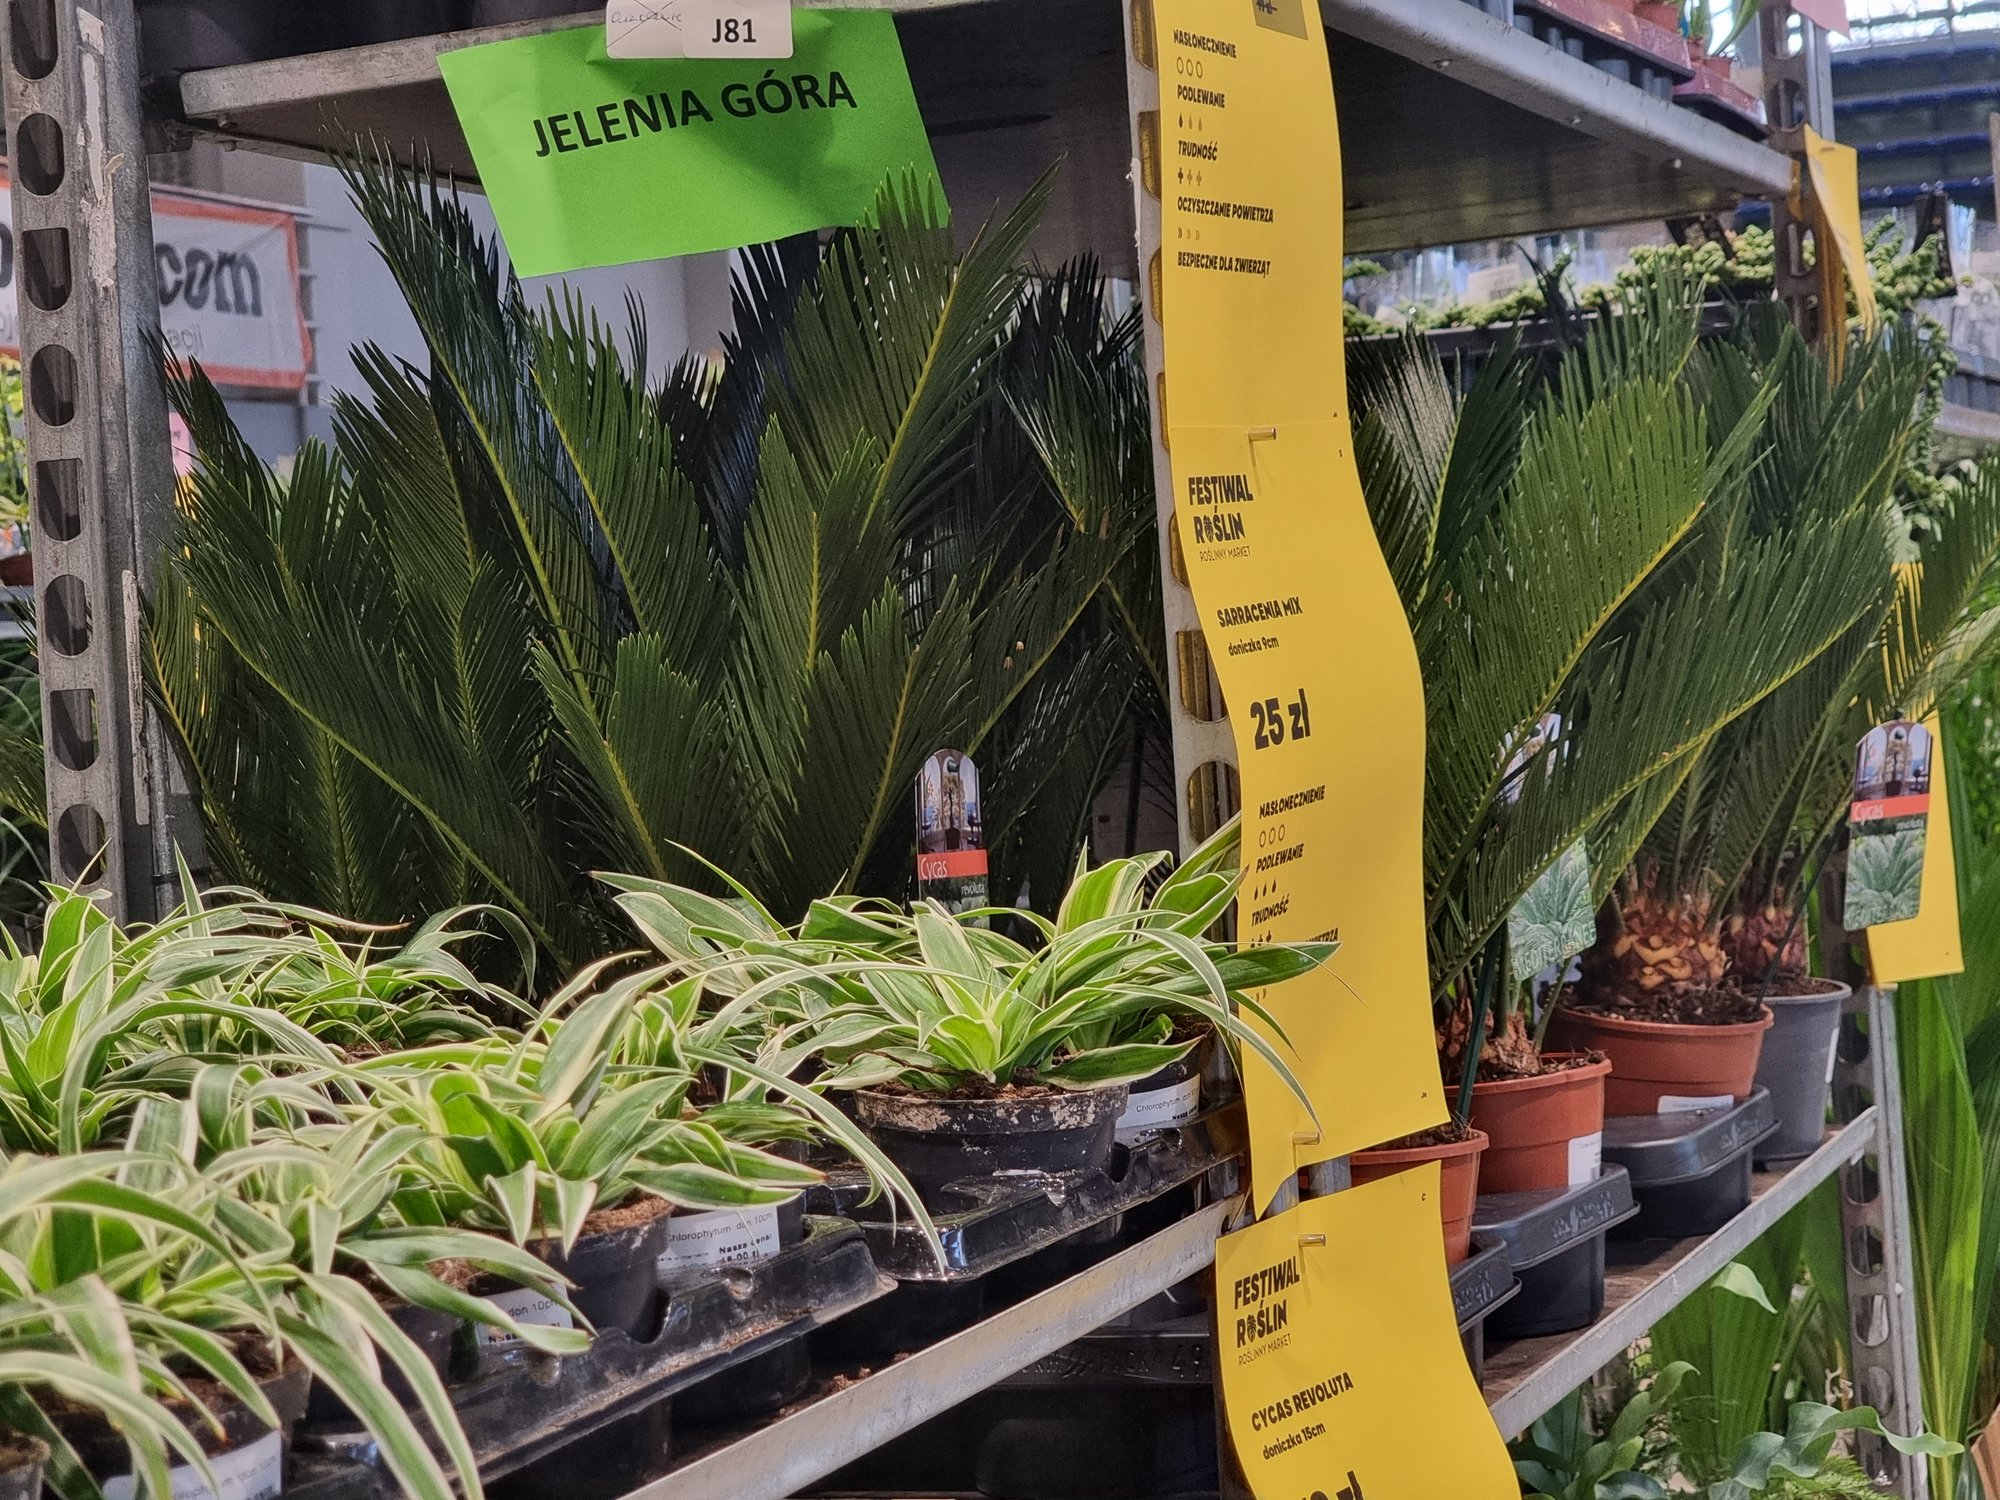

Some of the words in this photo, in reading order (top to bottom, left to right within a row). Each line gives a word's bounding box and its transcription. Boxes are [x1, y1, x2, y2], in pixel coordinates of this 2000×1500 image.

[712, 18, 757, 43] J81
[1174, 29, 1237, 58] NASŁONECZNIENIE
[1177, 84, 1226, 108] PODLEWANIE
[535, 89, 713, 158] JELENIA
[721, 70, 858, 118] GÓRA
[1178, 140, 1218, 161] TRUDNOŚĆ
[1177, 196, 1231, 218] OCZYSZCZANIE
[1231, 207, 1274, 223] POWIETRZA
[1177, 251, 1218, 271] BEZPIECZNE
[1219, 257, 1233, 272] DLA
[1234, 258, 1271, 279] ZWIERZĄT
[1188, 474, 1254, 505] FESTIWAL
[1193, 505, 1246, 544] ROŚLIN
[1227, 545, 1251, 559] MARKET
[1217, 599, 1283, 628] SARRACENIA
[1281, 596, 1303, 617] MIX
[1228, 638, 1262, 656] doniczka
[1261, 636, 1280, 650] 9cm
[1250, 697, 1285, 750] 25
[1259, 785, 1326, 819] NASŁONECZNIENIE
[920, 857, 948, 886] Cycas
[1256, 843, 1304, 874] PODLEWANIE
[961, 883, 985, 897] revoluta
[1251, 893, 1290, 927] TRUDNOŚĆ
[1234, 1256, 1300, 1310] FESTIWAL
[1237, 1299, 1288, 1349] ROŚLIN
[1238, 1343, 1267, 1367] ROŚLINNY
[1266, 1333, 1292, 1355] MARKET
[1251, 1398, 1293, 1431] CYCAS
[1292, 1372, 1354, 1413] REVOLUTA
[1263, 1433, 1303, 1460] doniczka
[1301, 1423, 1326, 1442] 15cm
